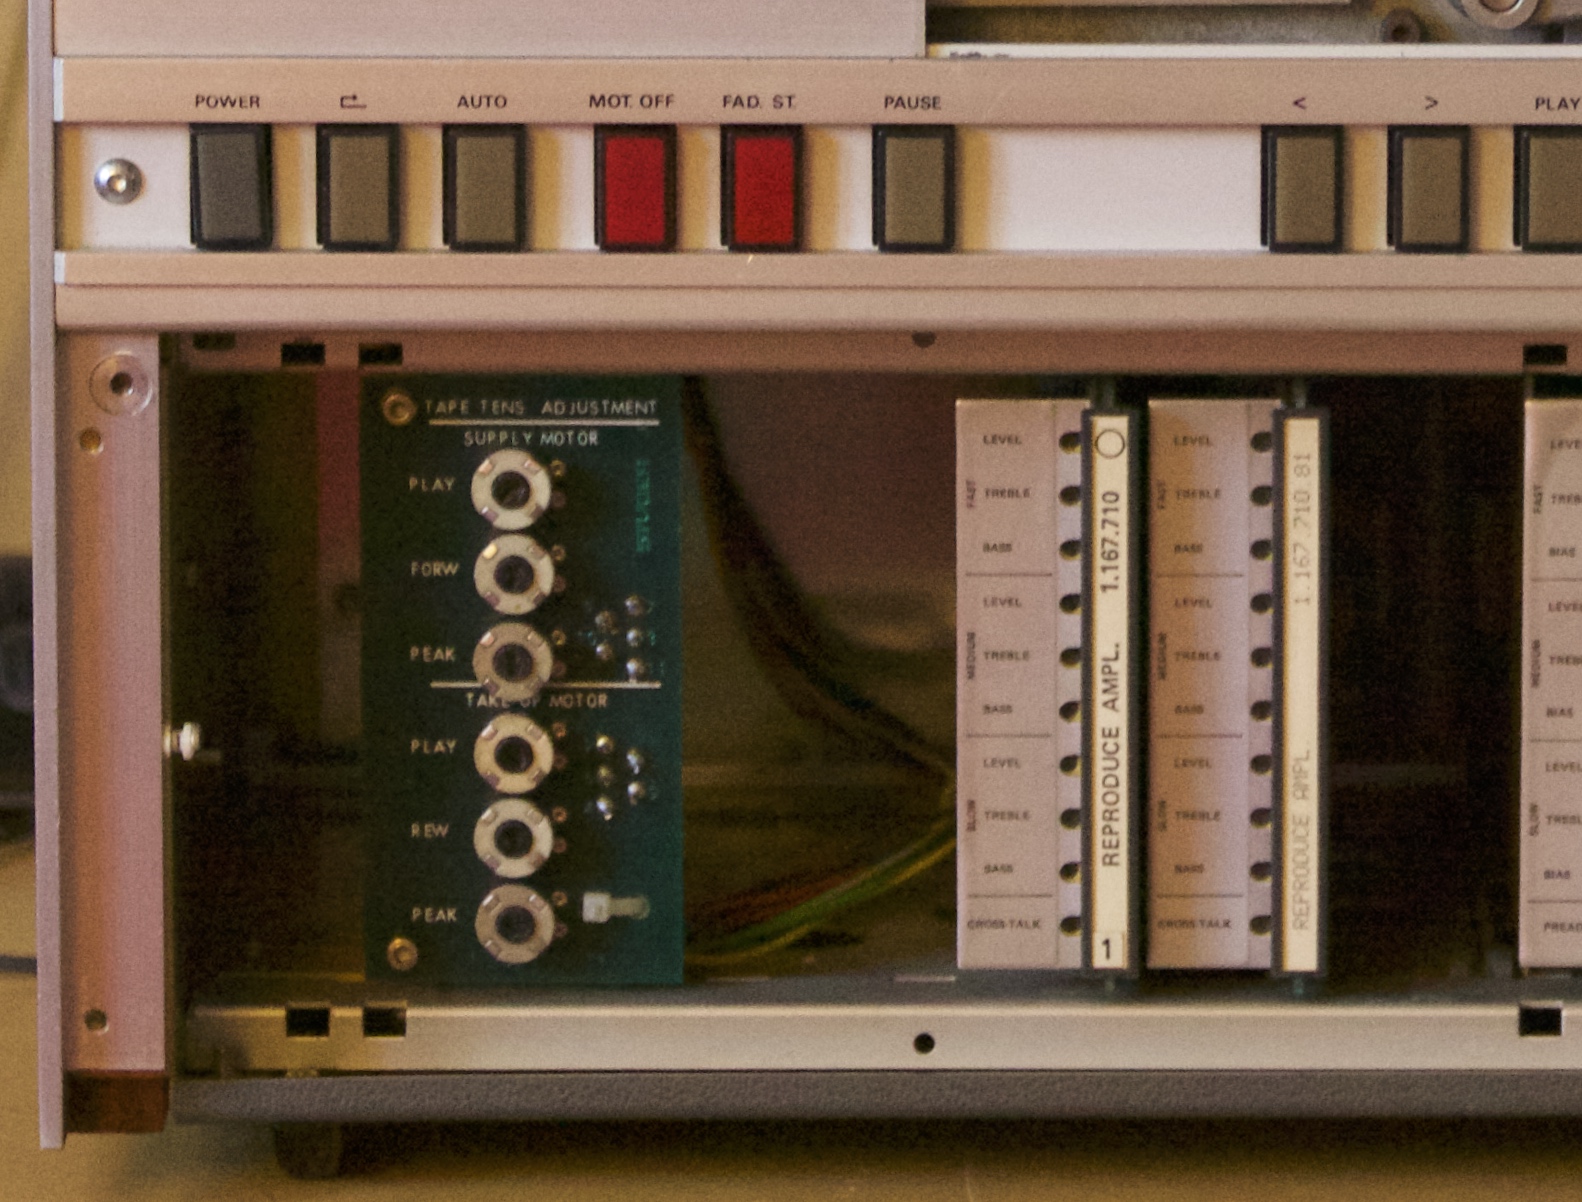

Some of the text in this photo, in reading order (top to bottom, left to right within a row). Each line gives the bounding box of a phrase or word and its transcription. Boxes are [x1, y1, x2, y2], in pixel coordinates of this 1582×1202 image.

[195, 94, 260, 109] POWER
[456, 94, 508, 109] AUTO
[588, 94, 675, 109] MOT. OFF
[884, 95, 942, 109] PAUSE
[1534, 97, 1581, 111] PLAY
[425, 399, 657, 416] TAPE TENS ADJUSTMENT
[463, 430, 599, 447] SUPPLY MOTOR
[982, 435, 1022, 445] LEVEL
[1174, 435, 1213, 446] LEVEL
[409, 477, 455, 492] PLAY
[984, 488, 1031, 498] TREBLE
[1100, 490, 1120, 593] 1.167.710
[411, 562, 459, 577] FORW
[982, 598, 1022, 608] LEVEL
[1174, 598, 1213, 608] LEVEL
[409, 647, 455, 662] PEAK
[984, 651, 1030, 661] TREBLE
[549, 693, 609, 708] MOTOR
[410, 739, 457, 754] PLAY
[1101, 642, 1120, 867] REPRODUCE AMPL.
[983, 758, 1022, 769] LEVEL
[1174, 759, 1212, 769] LEVEL
[984, 811, 1030, 821] TREBLE
[411, 823, 449, 838] REW
[1292, 815, 1310, 931] REPRODUCE
[412, 907, 458, 923] PEAK
[1101, 939, 1111, 960] 1
